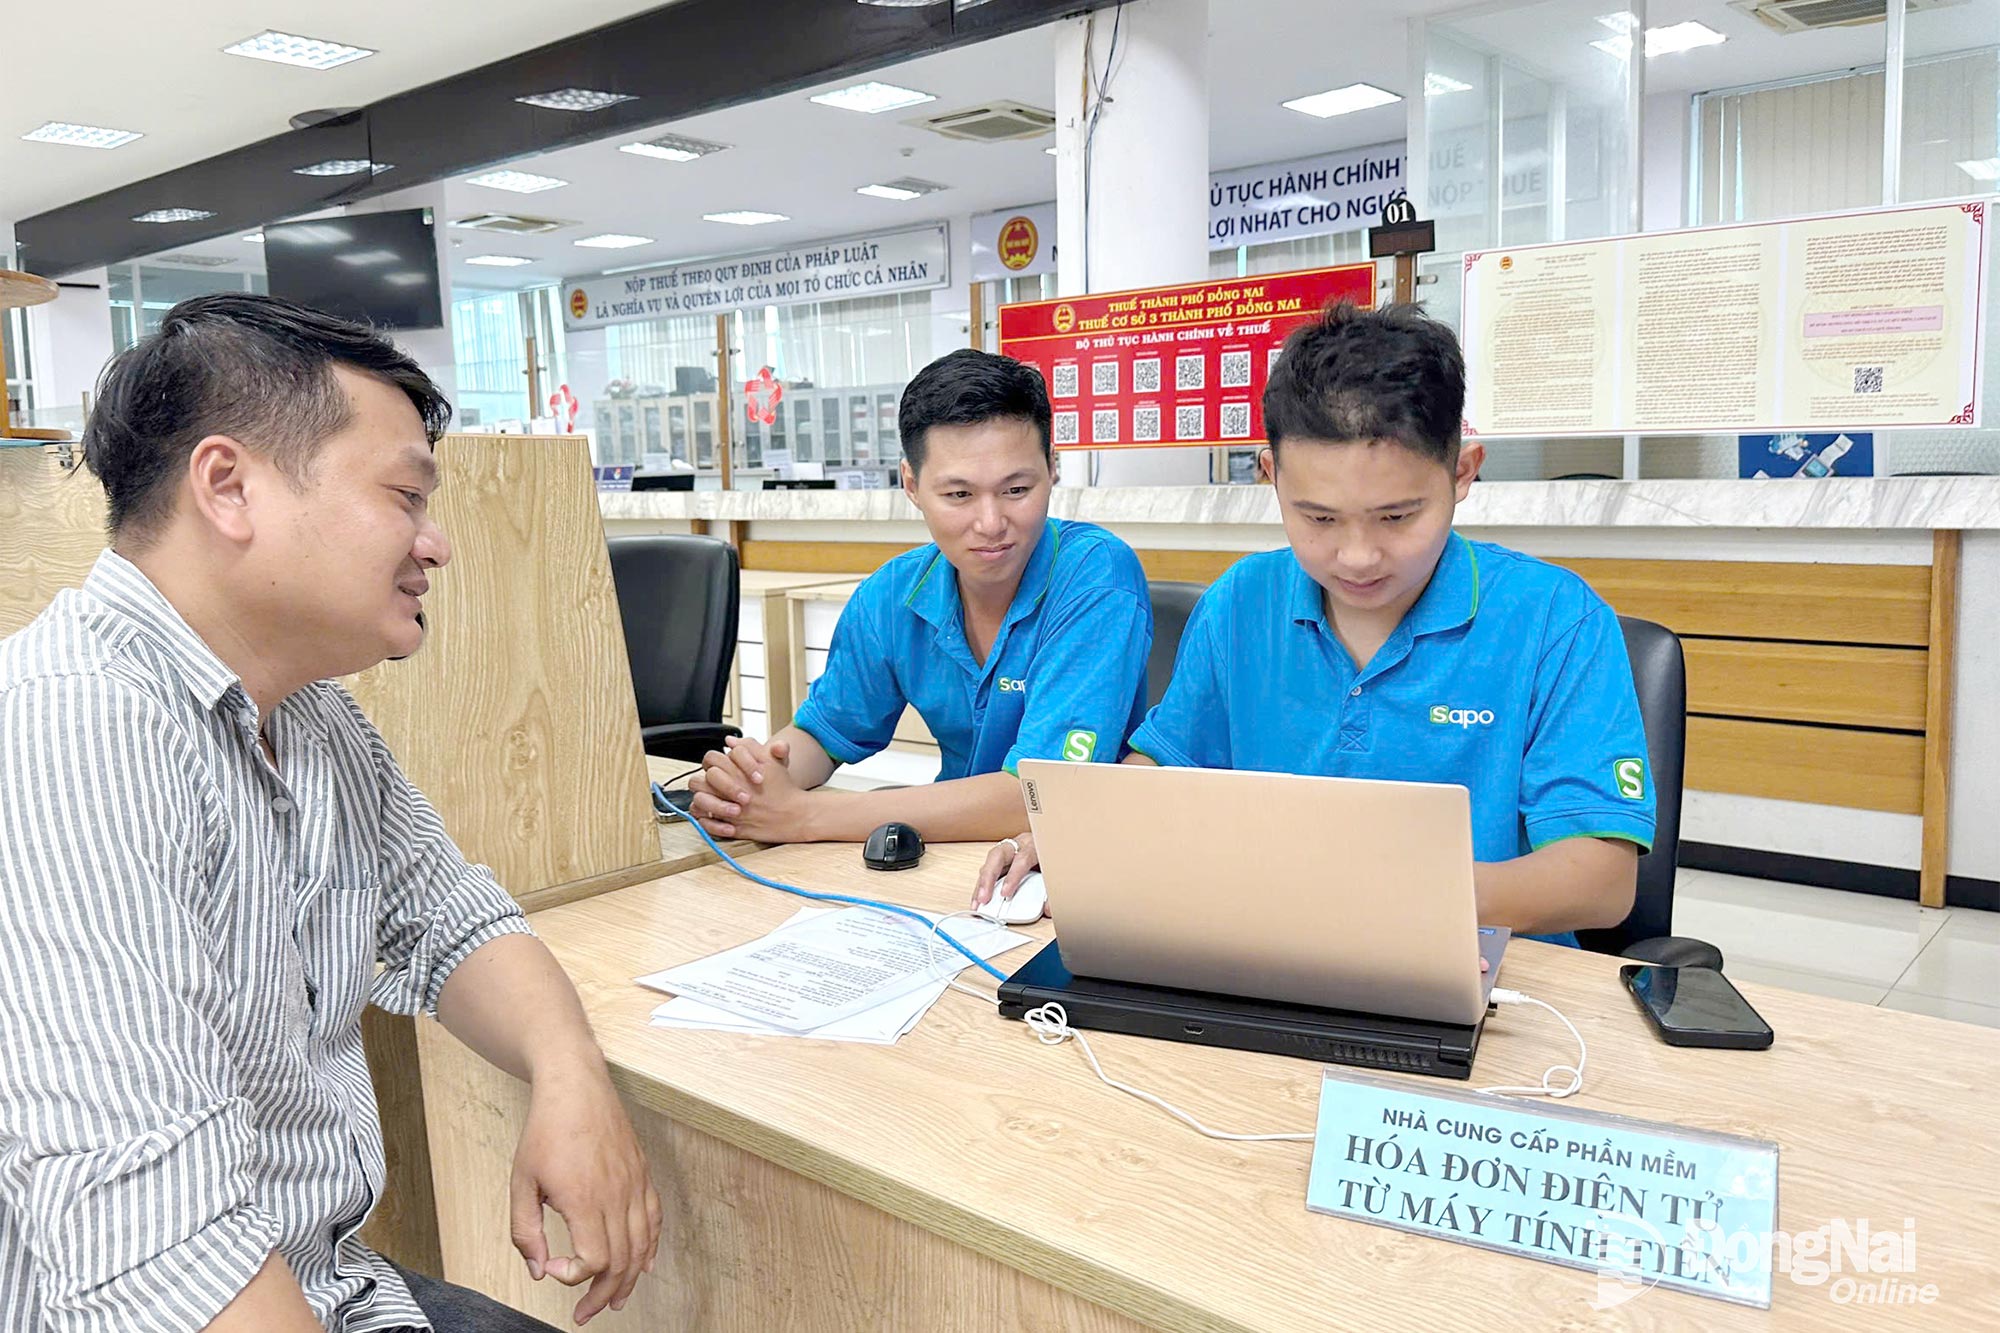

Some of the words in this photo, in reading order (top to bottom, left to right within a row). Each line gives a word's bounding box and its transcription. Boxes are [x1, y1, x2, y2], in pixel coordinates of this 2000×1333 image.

[1226, 180, 1264, 208] TỤC
[1269, 170, 1327, 198] HÀNH
[1333, 158, 1400, 187] CHÍNH
[1208, 216, 1234, 243] LỢI
[1297, 201, 1340, 226] CHO
[1386, 201, 1411, 225] 01
[650, 267, 679, 291] THUẾ
[682, 269, 712, 286] THEO
[715, 265, 739, 284] QUY
[742, 260, 772, 281] ĐỊNH
[775, 252, 801, 273] CỦA
[805, 246, 840, 268] PHÁP
[844, 242, 879, 265] LUẬT
[596, 301, 609, 319] LÀ
[612, 295, 645, 316] NGHĨA
[648, 299, 662, 314] VỤ
[665, 294, 680, 311] VÀ
[725, 285, 744, 307] LỢI
[747, 279, 772, 300] CỦA
[776, 280, 800, 299] MỌI
[804, 270, 821, 293] TỔ
[825, 269, 861, 291] CHỨC
[864, 264, 883, 286] CÁ
[888, 260, 928, 283] NHÂN
[1108, 297, 1138, 313] THUẾ
[1140, 295, 1178, 309] THÀNH
[1181, 289, 1204, 305] PHỐ
[1207, 286, 1240, 303] ĐỒNG
[1243, 286, 1264, 298] NAI
[1078, 314, 1109, 330] THUẾ
[1112, 315, 1128, 327] CƠ
[1131, 310, 1146, 325] SỞ
[1149, 313, 1158, 324] 3
[1160, 308, 1203, 322] THÀNH
[1206, 301, 1233, 318] PHỐ
[1236, 299, 1273, 315] ĐỒNG
[1277, 298, 1301, 311] NAI
[1075, 338, 1090, 351] BỘ
[1092, 335, 1115, 348] THỦ
[1117, 335, 1140, 347] TỤC
[1142, 331, 1174, 344] HÀNH
[1177, 328, 1214, 340] CHÍNH
[1217, 322, 1234, 337] VỀ
[1237, 320, 1271, 335] THUẾ
[1067, 732, 1093, 762] S
[1027, 781, 1038, 811] Lenovo
[1618, 761, 1643, 798] S
[1382, 1108, 1428, 1132] NHÀ
[1436, 1118, 1502, 1144] CUNG
[1510, 1128, 1559, 1154] CẤP
[1566, 1138, 1632, 1169] PHẦN
[1641, 1149, 1697, 1180] MỀM
[1344, 1133, 1430, 1177] HÓA
[1441, 1152, 1531, 1196] ĐƠN
[1541, 1170, 1649, 1219] ĐIỆN
[1661, 1190, 1724, 1232] TỬ
[1338, 1176, 1391, 1214] TỪ
[1397, 1192, 1494, 1236] MÁY
[1505, 1210, 1610, 1262] TÍNH
[1624, 1230, 1732, 1286] TIỀN
